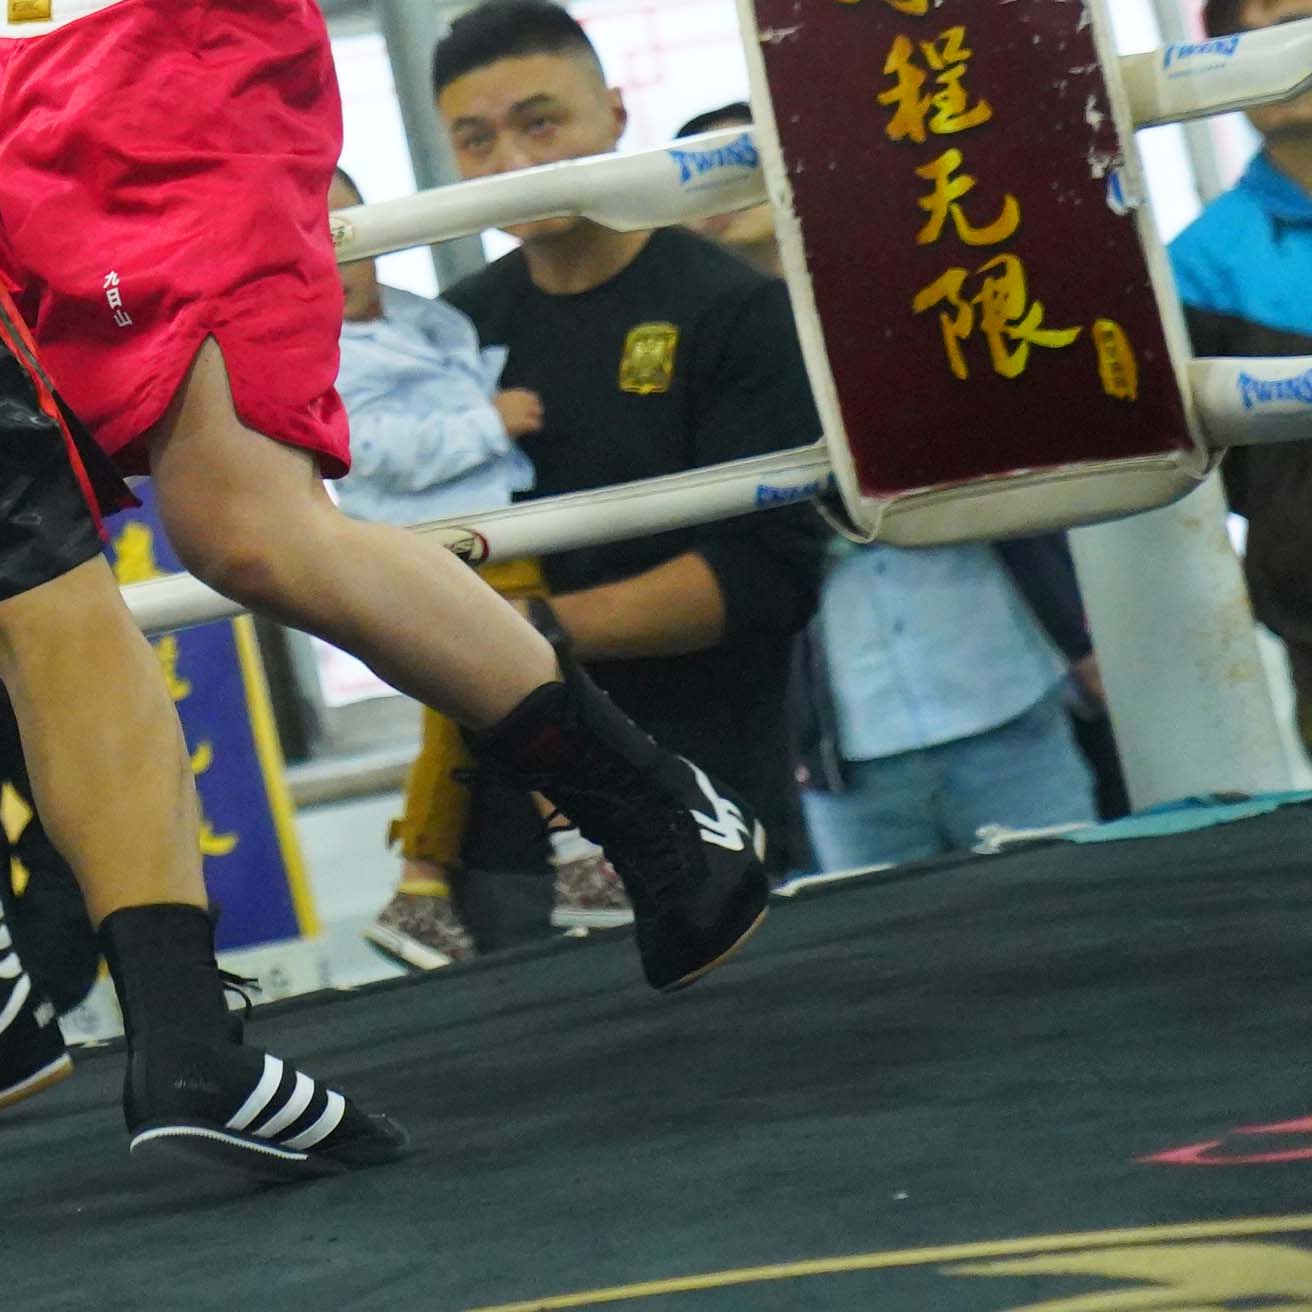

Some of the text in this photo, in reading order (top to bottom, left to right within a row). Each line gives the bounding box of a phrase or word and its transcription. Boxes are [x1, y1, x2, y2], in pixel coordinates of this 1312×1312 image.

[665, 131, 759, 184] TWINS
[102, 269, 133, 328] 九日山
